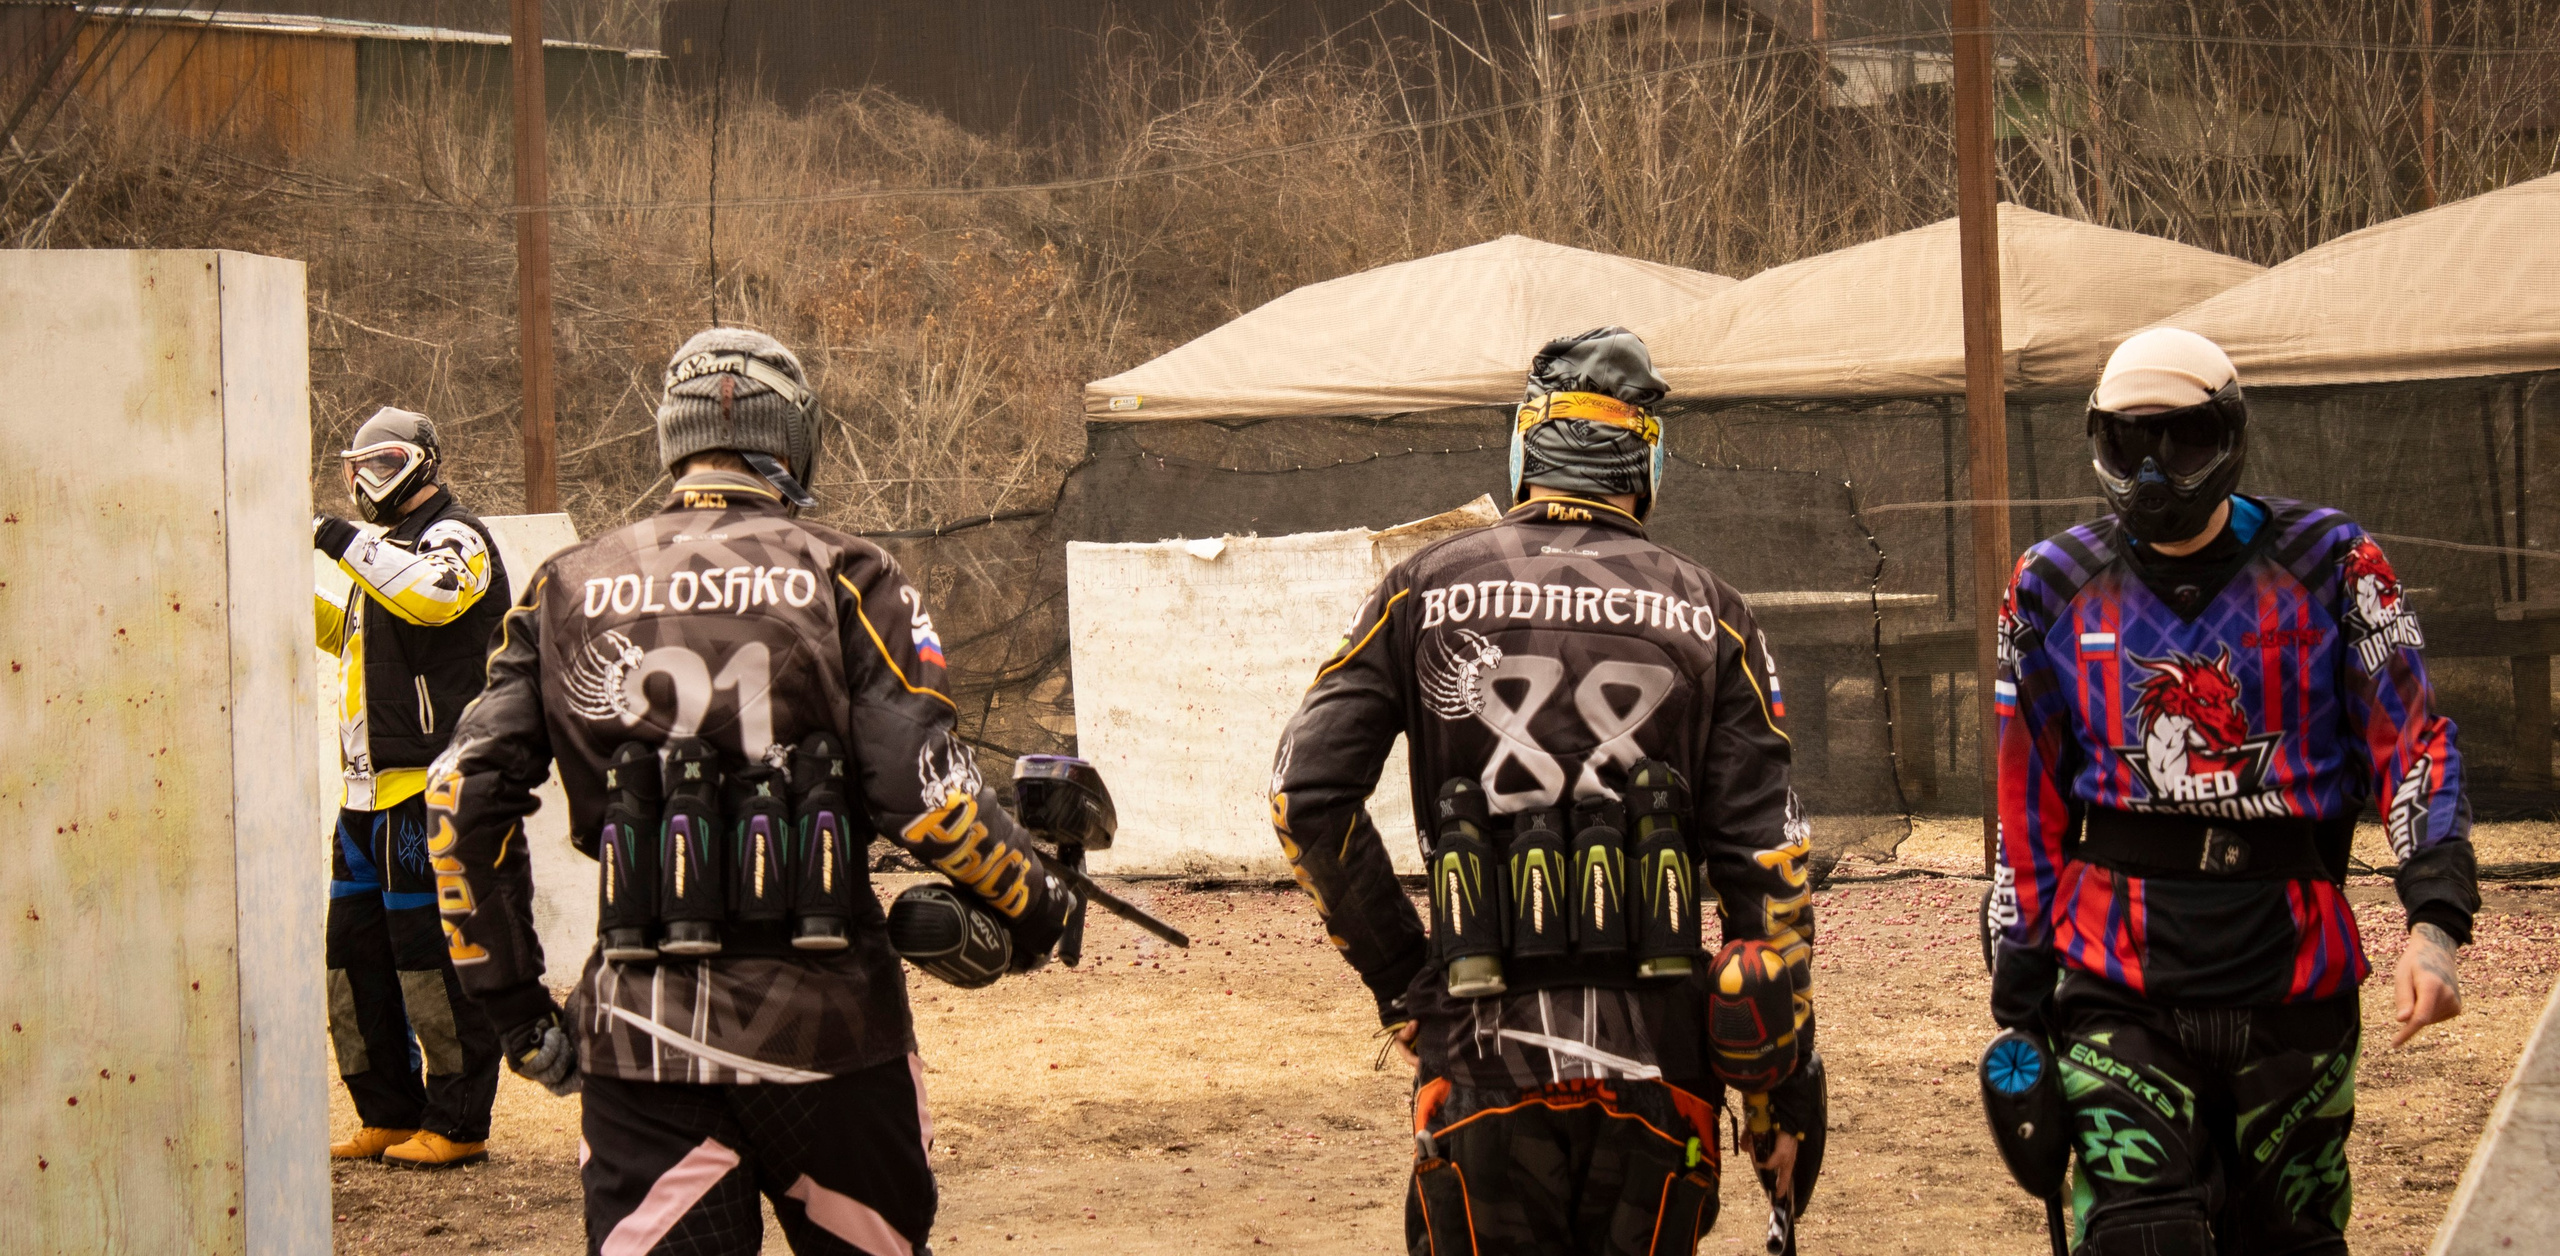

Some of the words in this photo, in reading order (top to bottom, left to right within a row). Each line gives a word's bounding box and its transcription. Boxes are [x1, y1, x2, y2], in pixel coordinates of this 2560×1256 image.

[1551, 547, 1599, 557] SLALOM
[584, 566, 817, 618] DOLOSHKO
[1421, 580, 1716, 641] BONDARENKO
[1478, 655, 1676, 815] 88
[2174, 770, 2238, 802] RED
[2069, 1043, 2176, 1119] EMPIRE
[2253, 1052, 2347, 1162] EMPIRE
